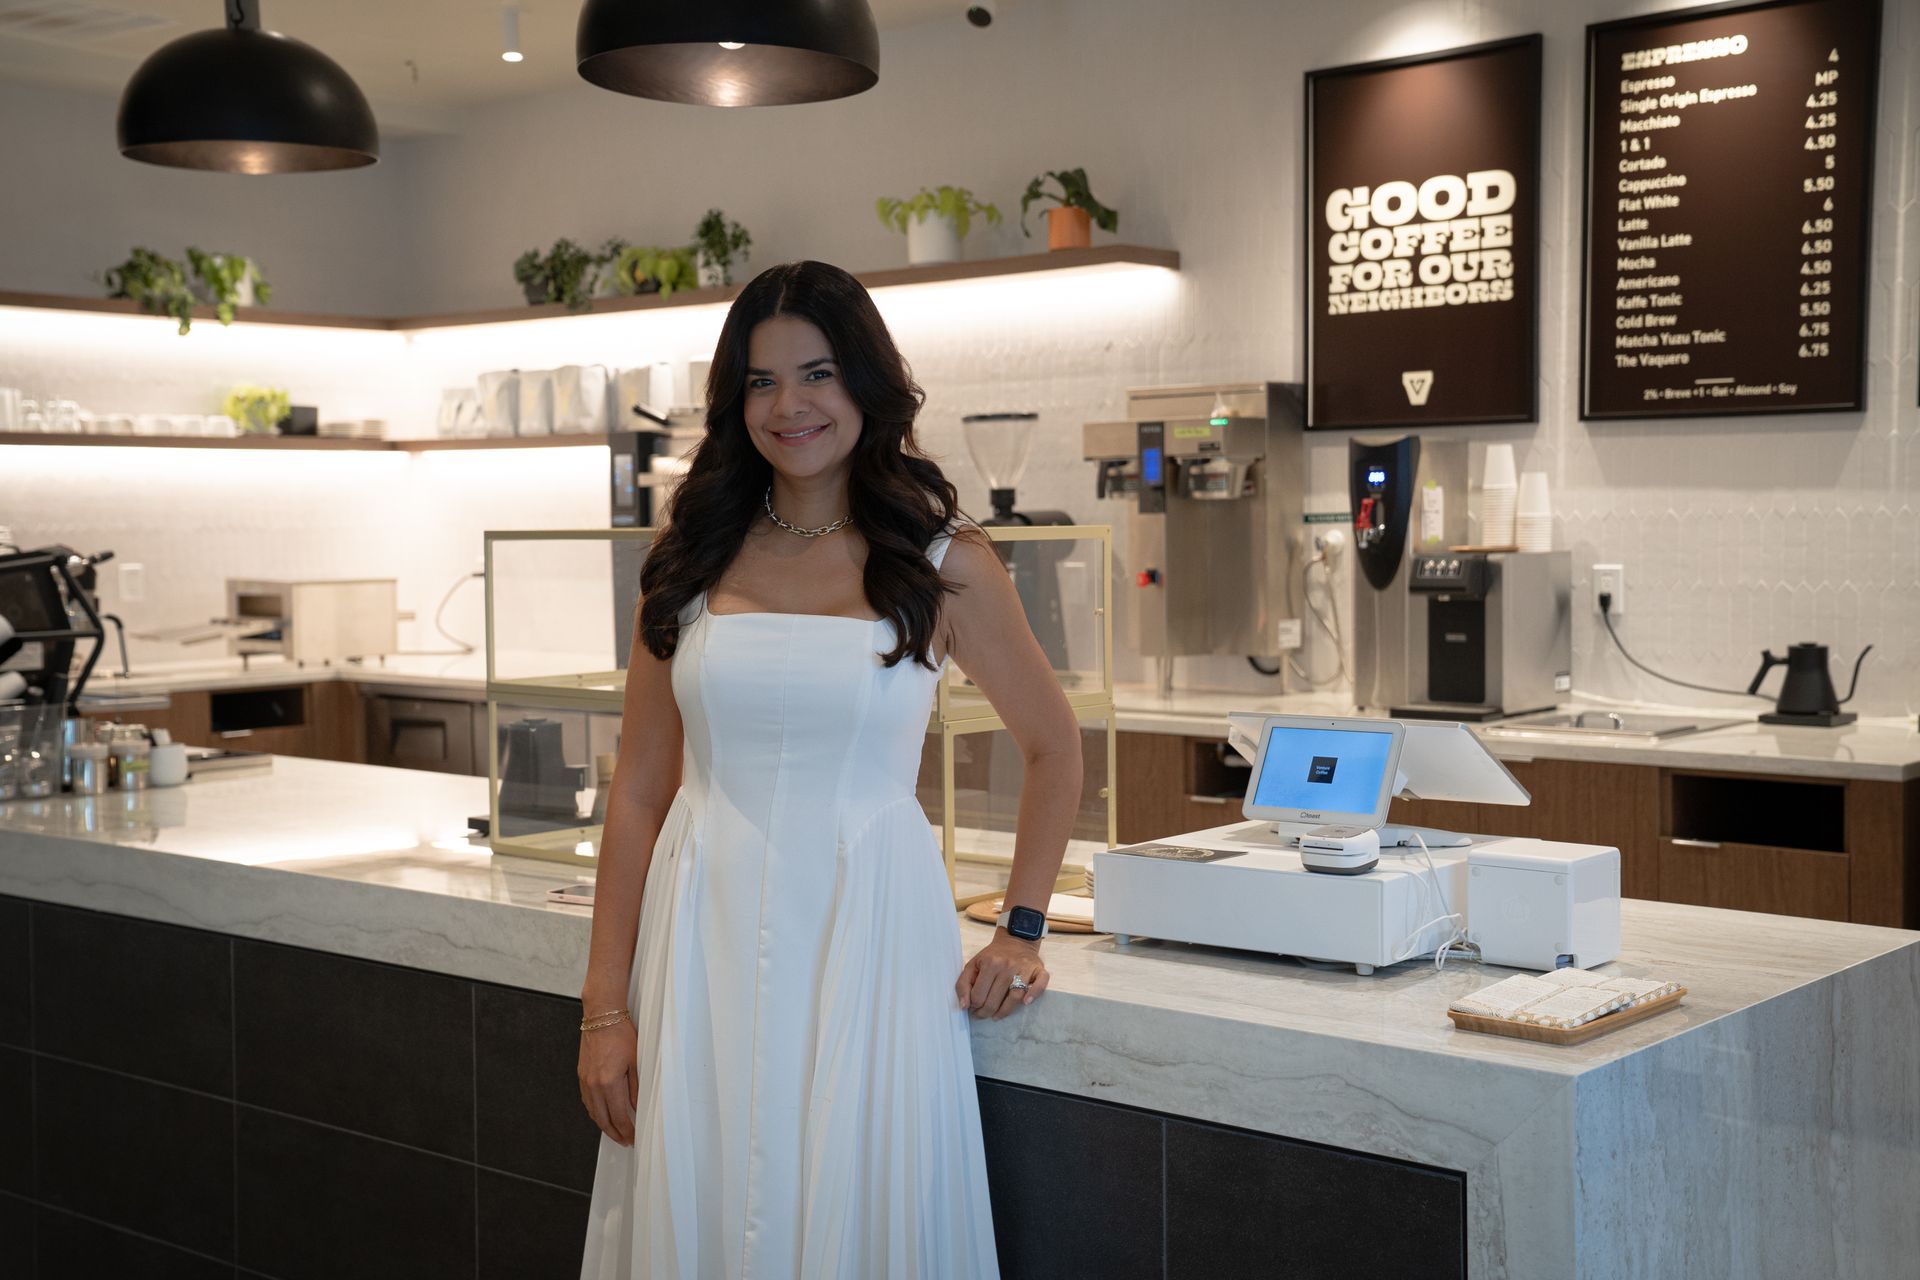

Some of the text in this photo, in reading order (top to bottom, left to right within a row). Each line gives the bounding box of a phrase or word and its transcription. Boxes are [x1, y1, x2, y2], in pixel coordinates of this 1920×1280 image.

[1620, 48, 1839, 94] Espresso 4
[1621, 34, 1748, 71] ESPRESSO
[1620, 70, 1839, 114] Single Origin Espresso MP
[1620, 91, 1838, 133] Macchiato 4.25
[1620, 112, 1837, 153] 1 & 1 4.25
[1618, 134, 1836, 173] Cortado 4.50
[1618, 154, 1835, 193] Cappuccino 5
[1325, 169, 1517, 232] GOOD
[1618, 176, 1835, 212] Flat White 5.50
[1618, 197, 1834, 232] Latte 6
[1327, 213, 1514, 264] COFFEE
[1617, 218, 1834, 251] Vanilla Latte 6.50
[1327, 248, 1515, 293] FOR OUR
[1617, 238, 1833, 271] Mocha 6.50
[1616, 259, 1832, 291] Americano 4.50
[1327, 278, 1515, 316] NEIGHBORS
[1616, 280, 1831, 310] Kaffe Tonic 6.25
[1615, 301, 1831, 330] Cold Brew 5.50
[1615, 321, 1830, 349] Matcha Yuzu Tonic 6.75
[1615, 342, 1829, 369] The Vaquero 6.75
[1664, 387, 1692, 400] Breve
[1734, 383, 1772, 396] Almond
[1777, 382, 1798, 396] Soy
